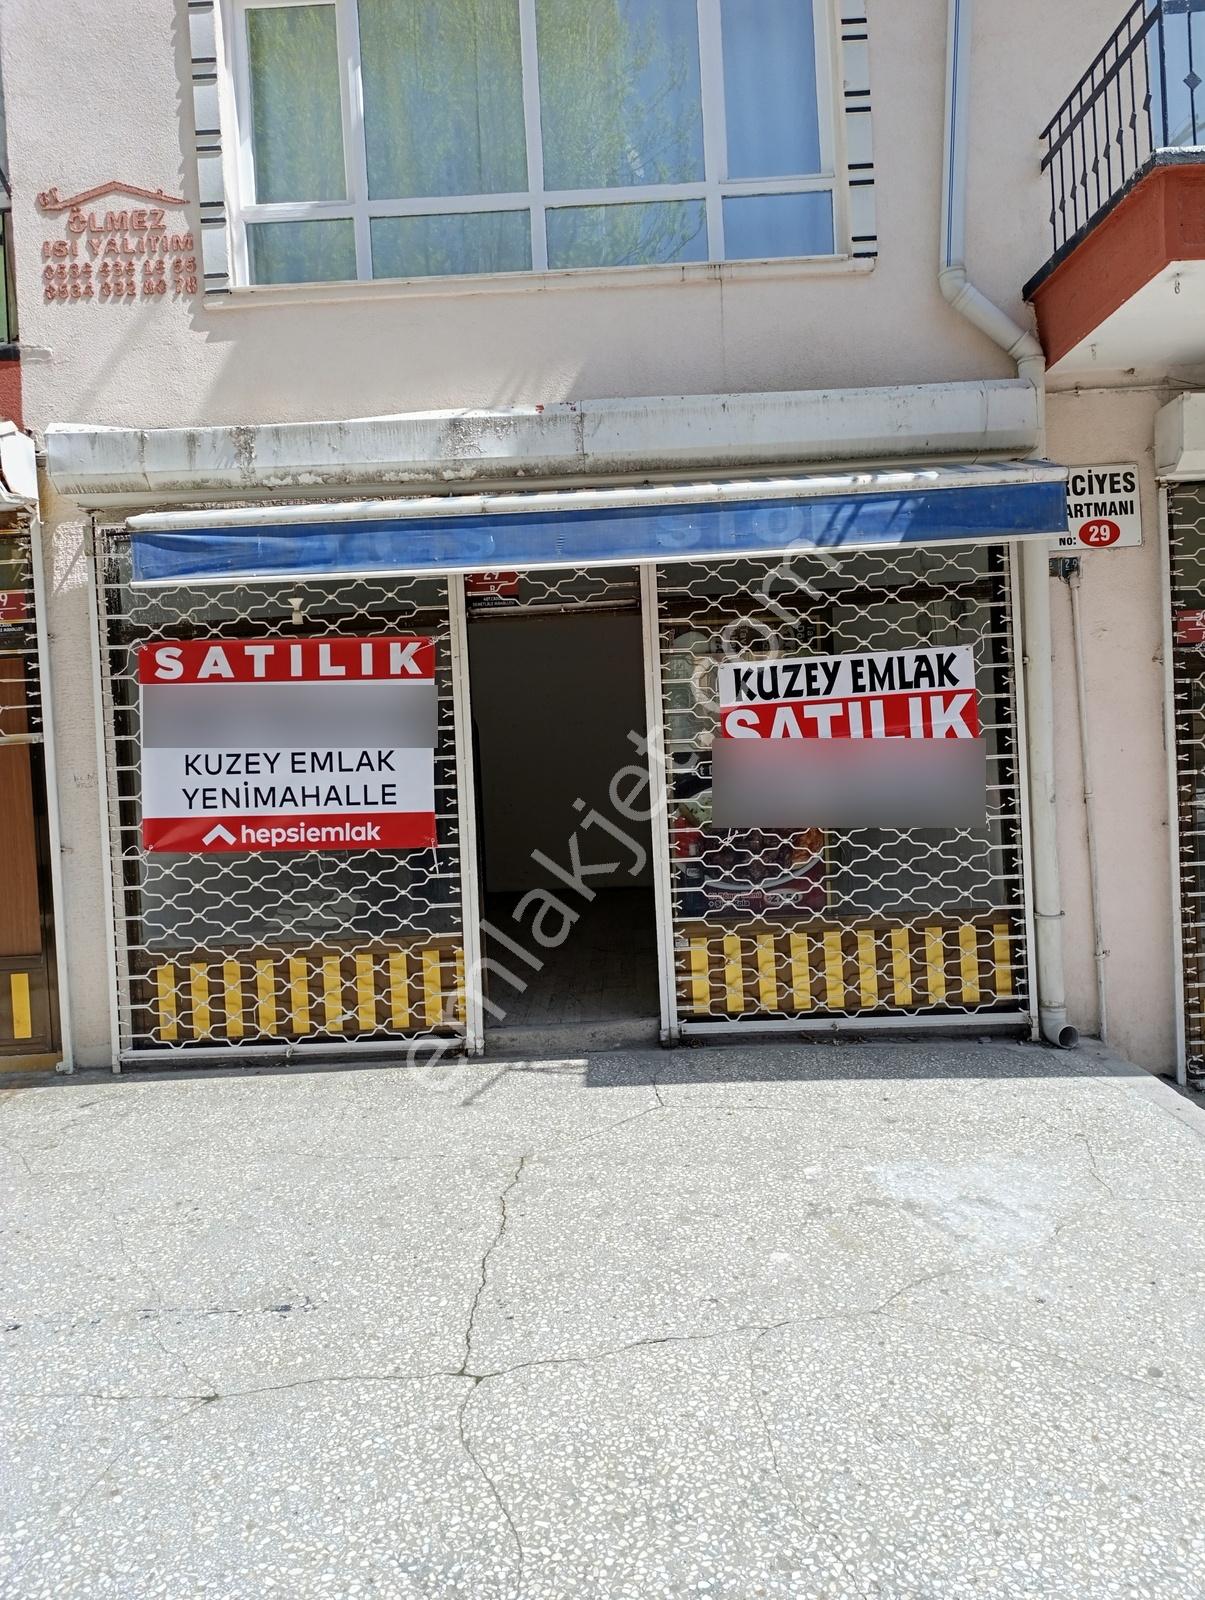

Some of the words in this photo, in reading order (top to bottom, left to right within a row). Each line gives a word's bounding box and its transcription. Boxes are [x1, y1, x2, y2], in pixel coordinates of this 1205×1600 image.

[69, 208, 165, 232] ÖLMEZ
[43, 240, 79, 258] ISI
[1089, 525, 1111, 542] 29
[154, 643, 422, 679] SATILIK
[734, 661, 841, 701] KUZEY
[851, 652, 959, 692] EMLAK
[184, 752, 281, 776] KUZEY
[290, 749, 396, 773] EMLAK
[181, 780, 398, 810] YENİMAHALLE
[240, 821, 382, 846] hepsiemlak
